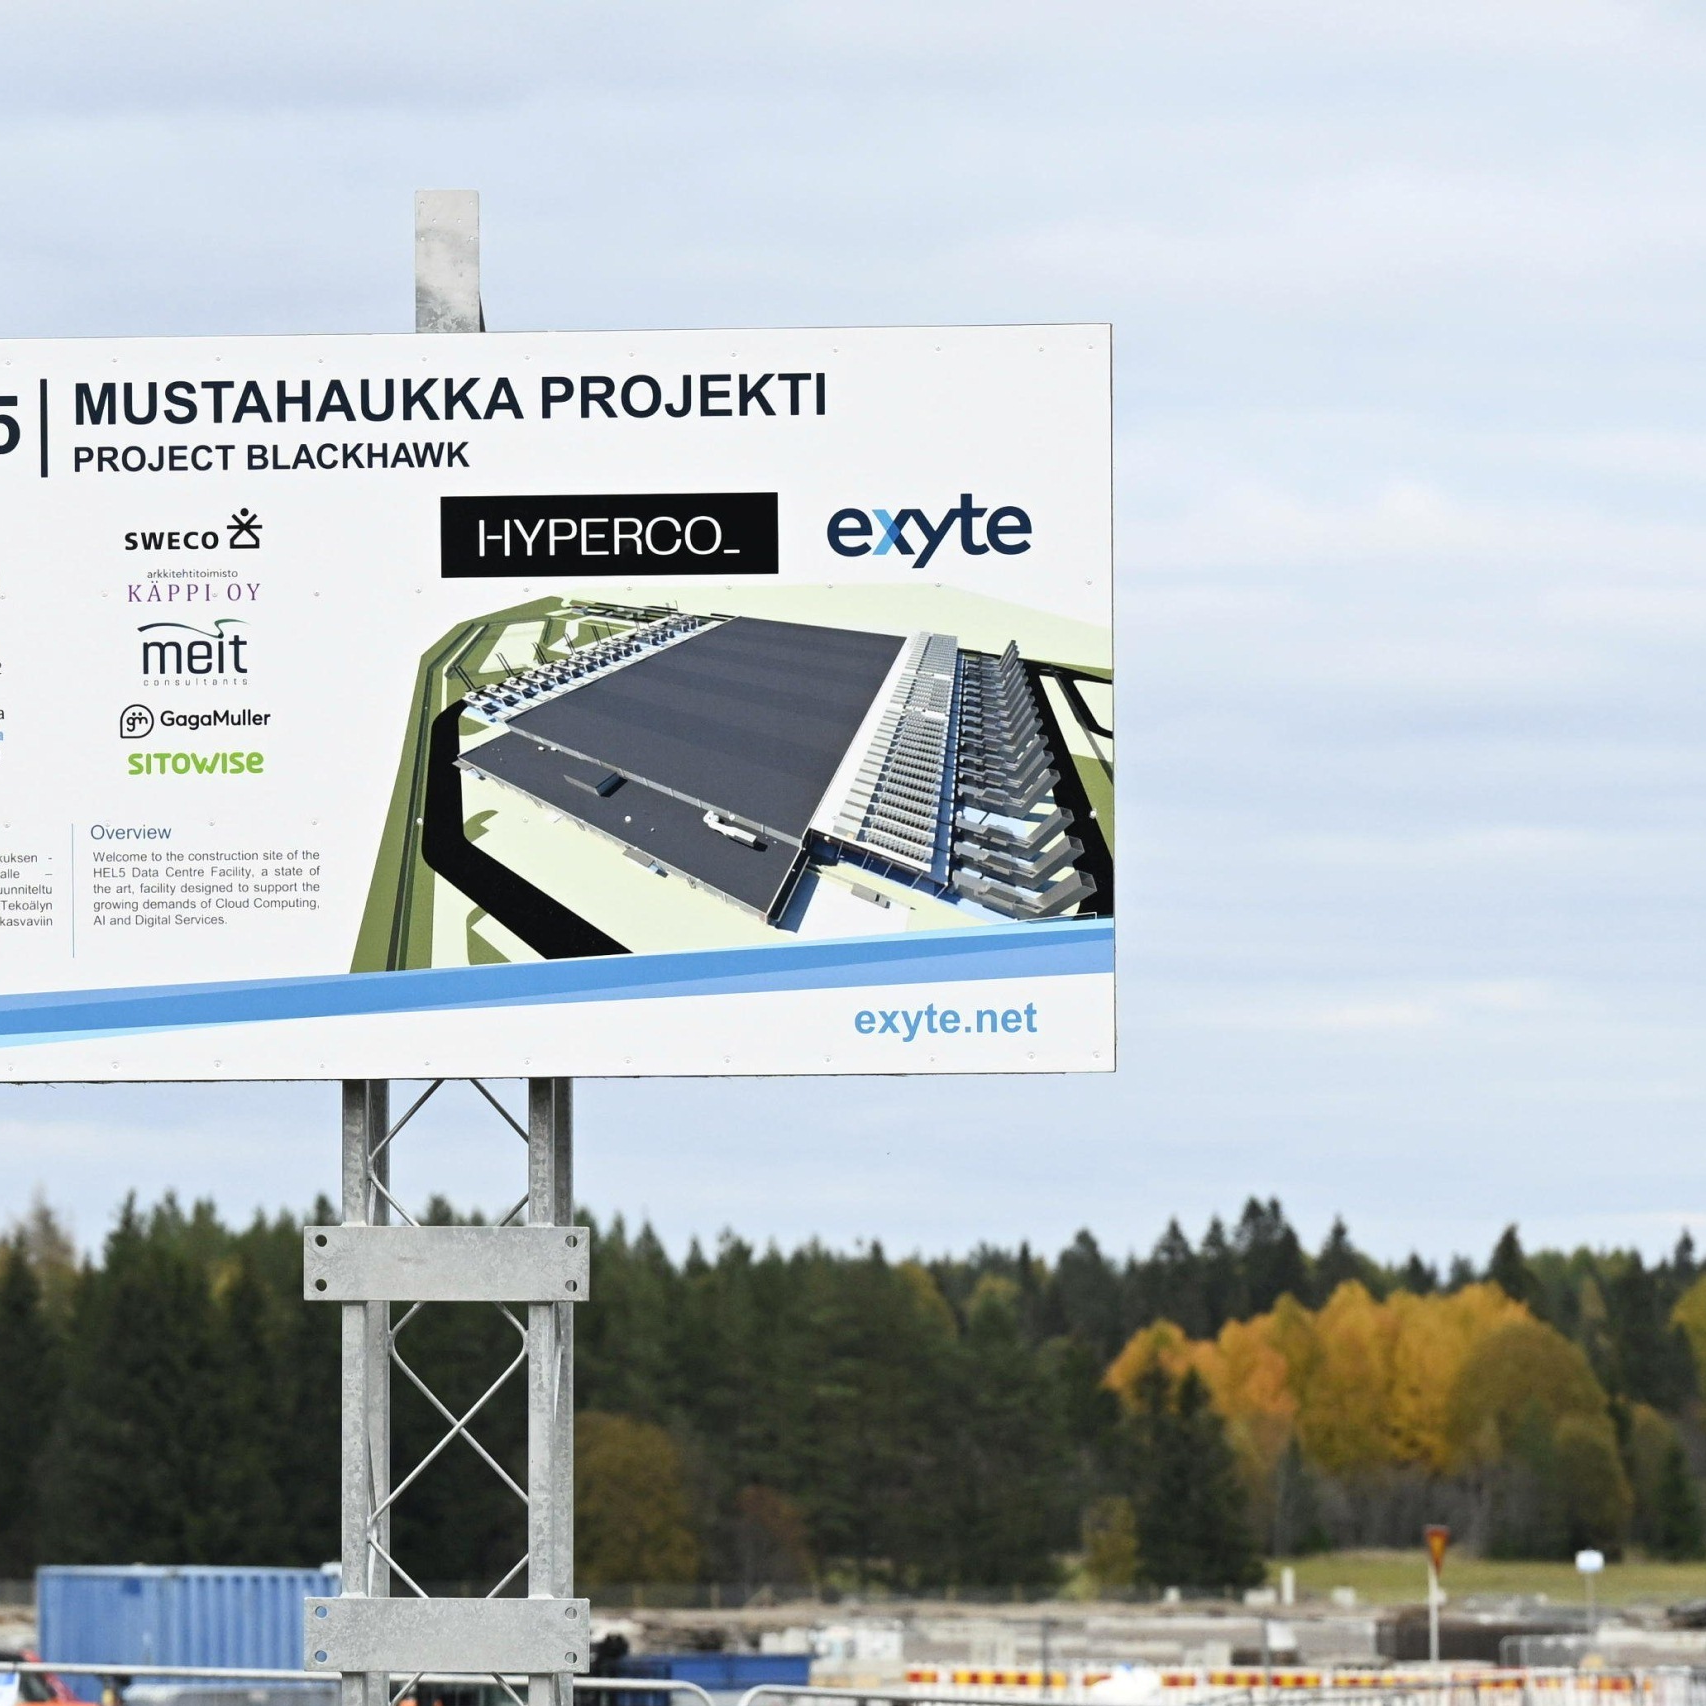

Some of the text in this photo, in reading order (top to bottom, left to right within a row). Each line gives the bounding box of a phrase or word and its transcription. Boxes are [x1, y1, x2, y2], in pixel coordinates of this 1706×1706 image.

[76, 373, 825, 425] MUSTAHAUKKA PROJEKTI
[75, 442, 469, 472] PROJECT BLACKHAWK
[827, 493, 1032, 568] exyte
[125, 531, 219, 550] SWECO
[147, 569, 238, 578] arkkitehtitoimisto
[128, 581, 260, 602] KÄPPI OY
[143, 634, 247, 674] meit
[144, 678, 247, 686] consultants
[160, 709, 270, 730] GagaMuller
[91, 825, 171, 840] Overview
[93, 850, 319, 862] Welcome to the construction site of the
[94, 868, 125, 878] HEL5
[132, 867, 158, 877] Data
[166, 867, 204, 877] Centre
[211, 866, 254, 879] Facility,
[275, 867, 302, 876] state
[310, 866, 320, 876] of
[93, 882, 320, 895] the art, facility designed to support the
[0, 900, 52, 913] Tekoälyn
[94, 898, 319, 912] growing demands of Cloud Computing,
[0, 916, 52, 926] kasvaviin
[94, 914, 227, 927] AI and Digital Services.
[855, 1003, 1037, 1042] exyte.net
